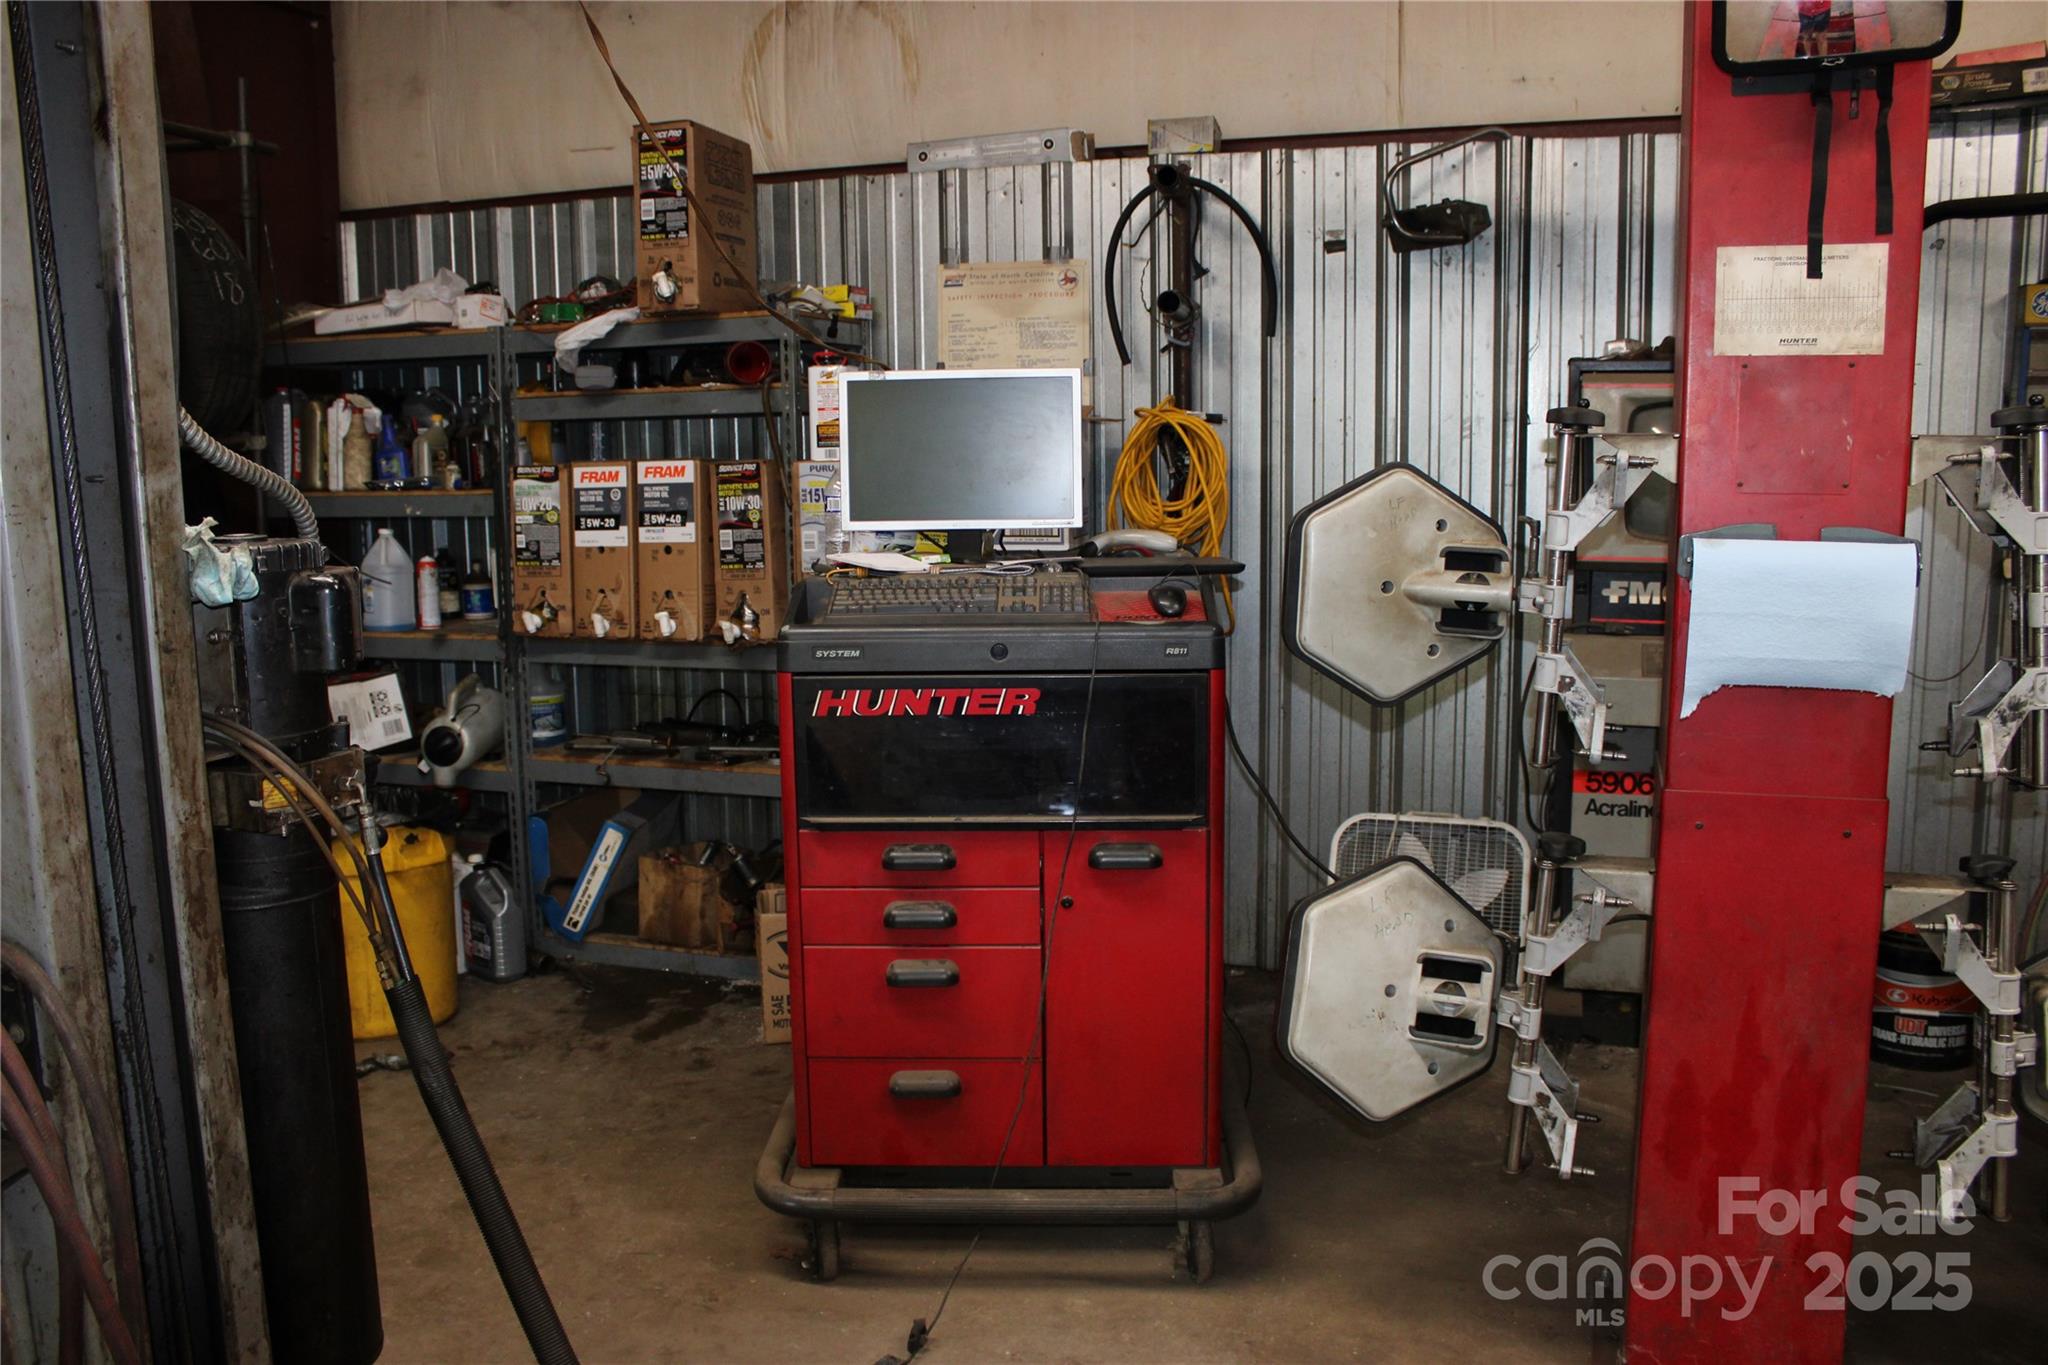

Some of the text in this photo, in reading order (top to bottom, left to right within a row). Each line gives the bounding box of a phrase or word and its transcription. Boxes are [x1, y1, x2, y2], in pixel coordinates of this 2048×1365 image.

[1029, 291, 1075, 299] PROCEDURE
[643, 465, 686, 479] FRAM
[809, 464, 835, 473] PURU
[580, 471, 620, 483] FRAM
[726, 495, 761, 511] 10W-30
[586, 518, 616, 528] 5W-20
[651, 513, 682, 524] 5W-40
[1602, 581, 1667, 605] FM
[815, 650, 861, 658] SYSTEM
[812, 687, 1041, 717] HUNTER
[1585, 771, 1655, 794] 5906
[771, 995, 784, 1016] SAE
[1894, 1015, 1928, 1036] UDT
